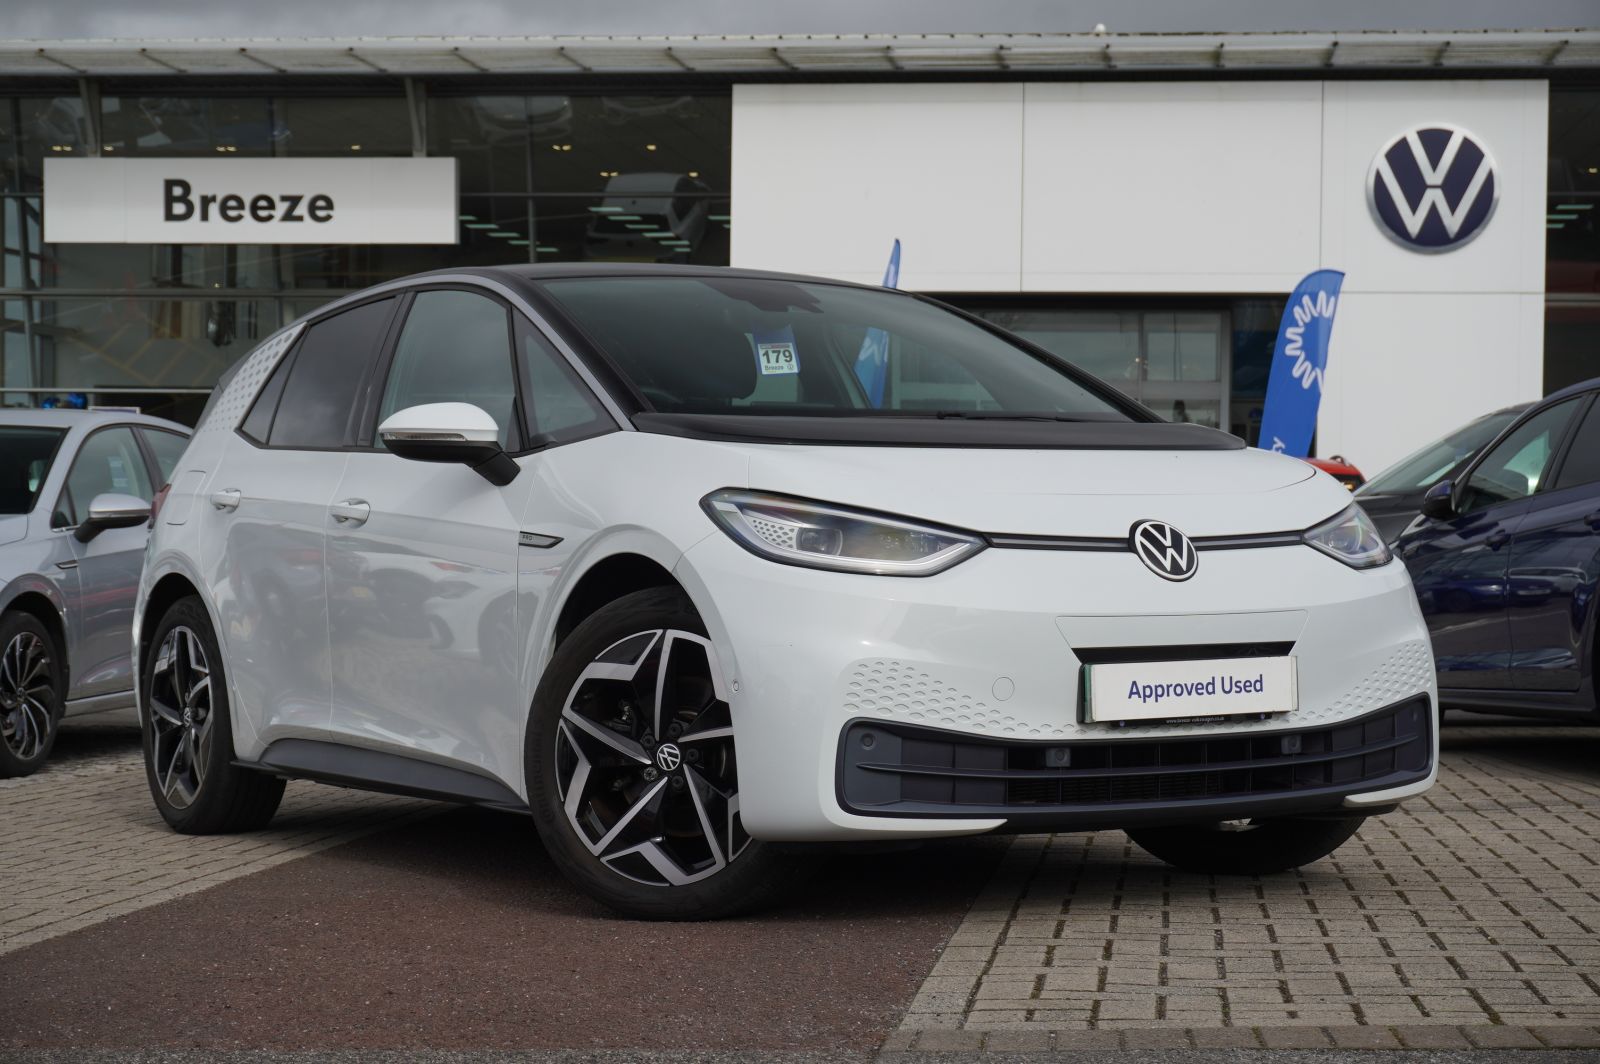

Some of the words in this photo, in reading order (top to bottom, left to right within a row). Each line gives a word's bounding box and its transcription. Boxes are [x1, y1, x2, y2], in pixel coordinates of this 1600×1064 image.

[164, 178, 334, 223] Breeze
[762, 349, 793, 364] 179
[1128, 676, 1216, 703] Approved
[1221, 674, 1264, 695] Used
